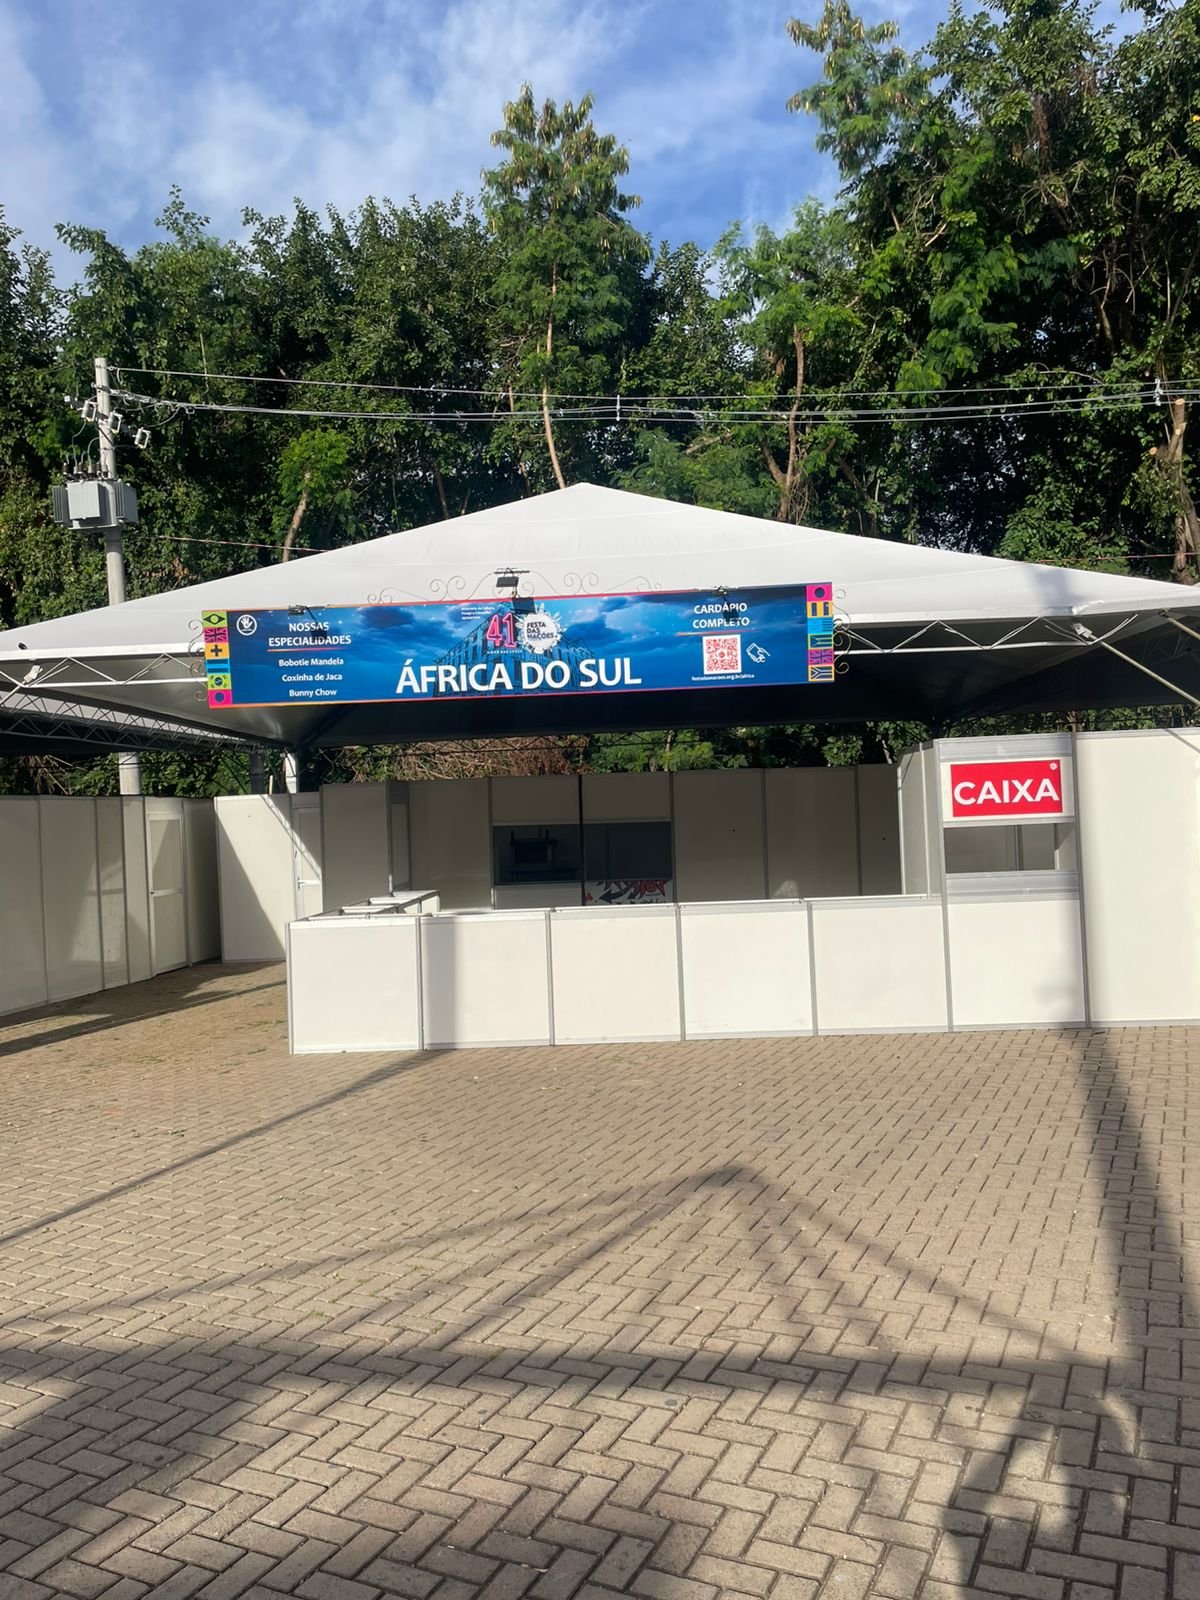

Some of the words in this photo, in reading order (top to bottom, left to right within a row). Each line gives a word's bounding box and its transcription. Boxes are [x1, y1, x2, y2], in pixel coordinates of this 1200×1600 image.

[693, 601, 748, 615] CARDÁPIO
[288, 621, 330, 632] NOSSAS
[526, 621, 547, 629] FESTA
[692, 616, 750, 629] COMPLETO
[486, 612, 517, 648] 41
[268, 635, 352, 647] ESPECIALIDADES
[278, 658, 310, 667] Bobotie
[310, 657, 345, 666] Mandela
[281, 673, 314, 682] Coxinha
[314, 673, 325, 681] de
[325, 673, 343, 681] Jaca
[395, 658, 513, 694] ÁFRICA
[521, 660, 571, 689] DO
[579, 657, 642, 688] SUL
[289, 688, 314, 698] Bunny
[314, 687, 338, 696] Chow
[953, 778, 1060, 805] CAIXA
